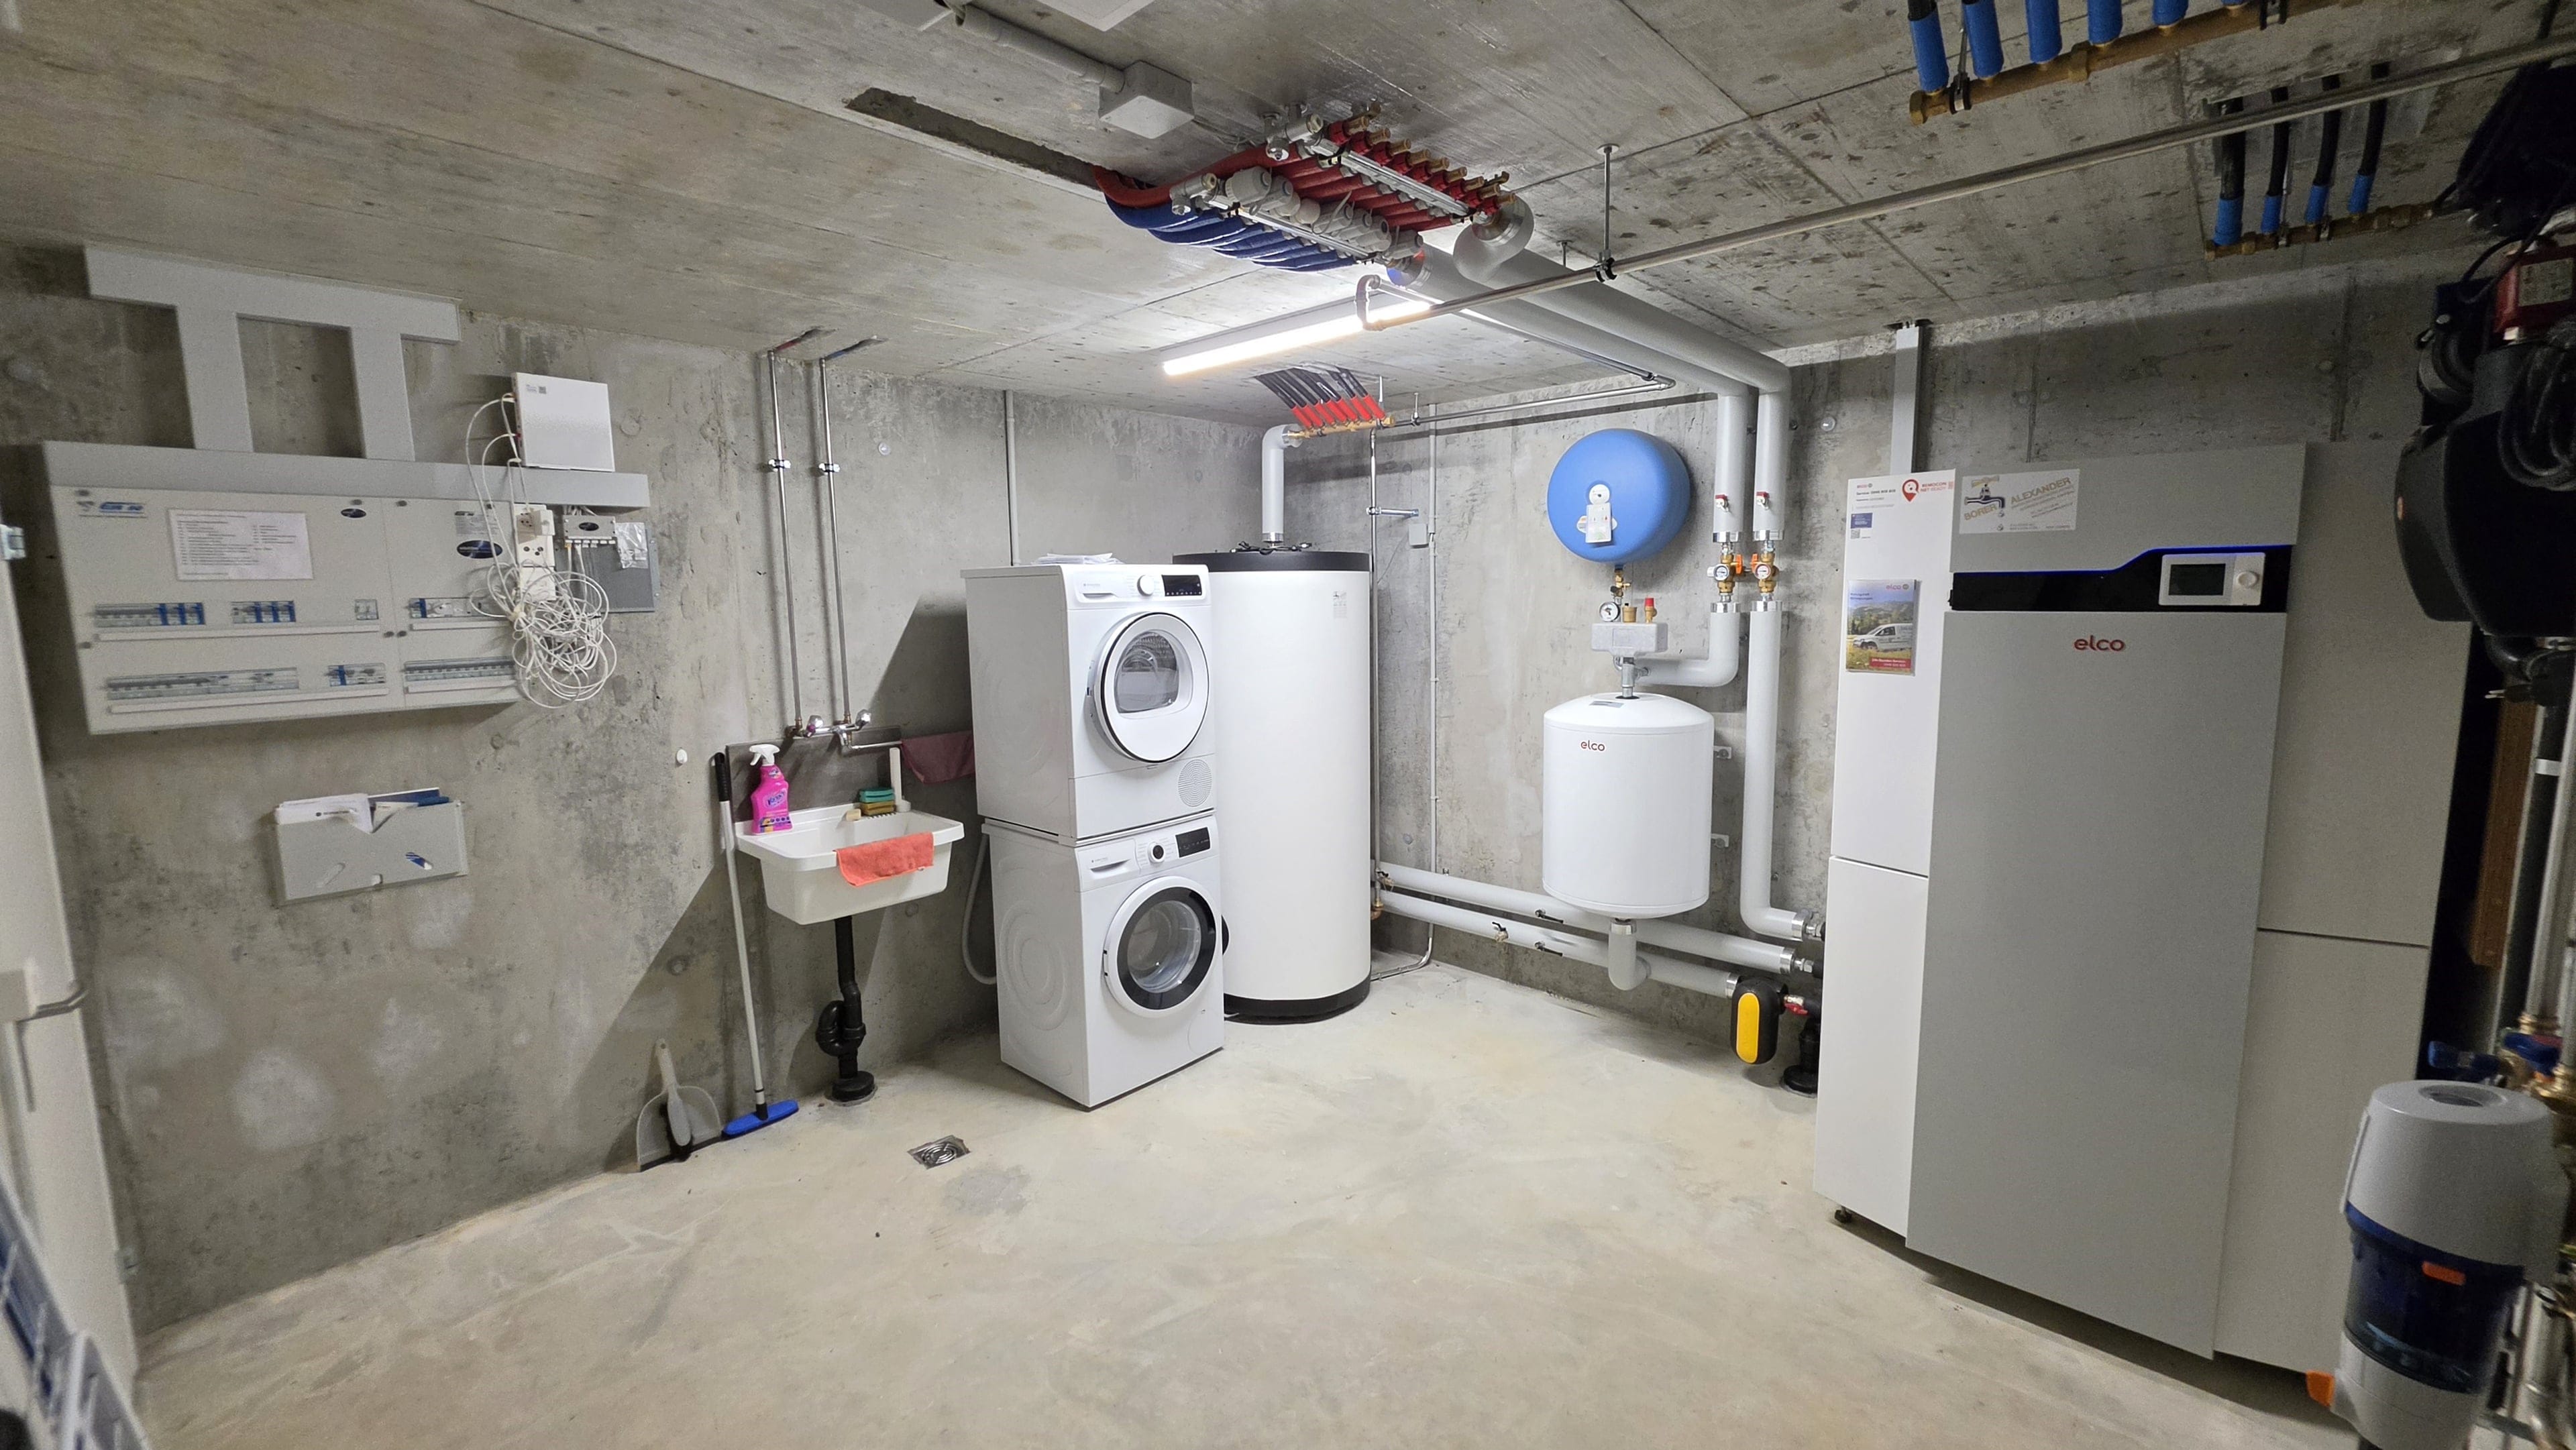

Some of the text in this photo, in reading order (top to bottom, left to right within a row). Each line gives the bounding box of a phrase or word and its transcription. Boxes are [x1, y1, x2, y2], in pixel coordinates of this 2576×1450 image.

[2011, 477, 2072, 504] ALEXANDER
[1964, 504, 1997, 520] BORER
[2074, 634, 2125, 651] elco
[1580, 740, 1605, 751] elco
